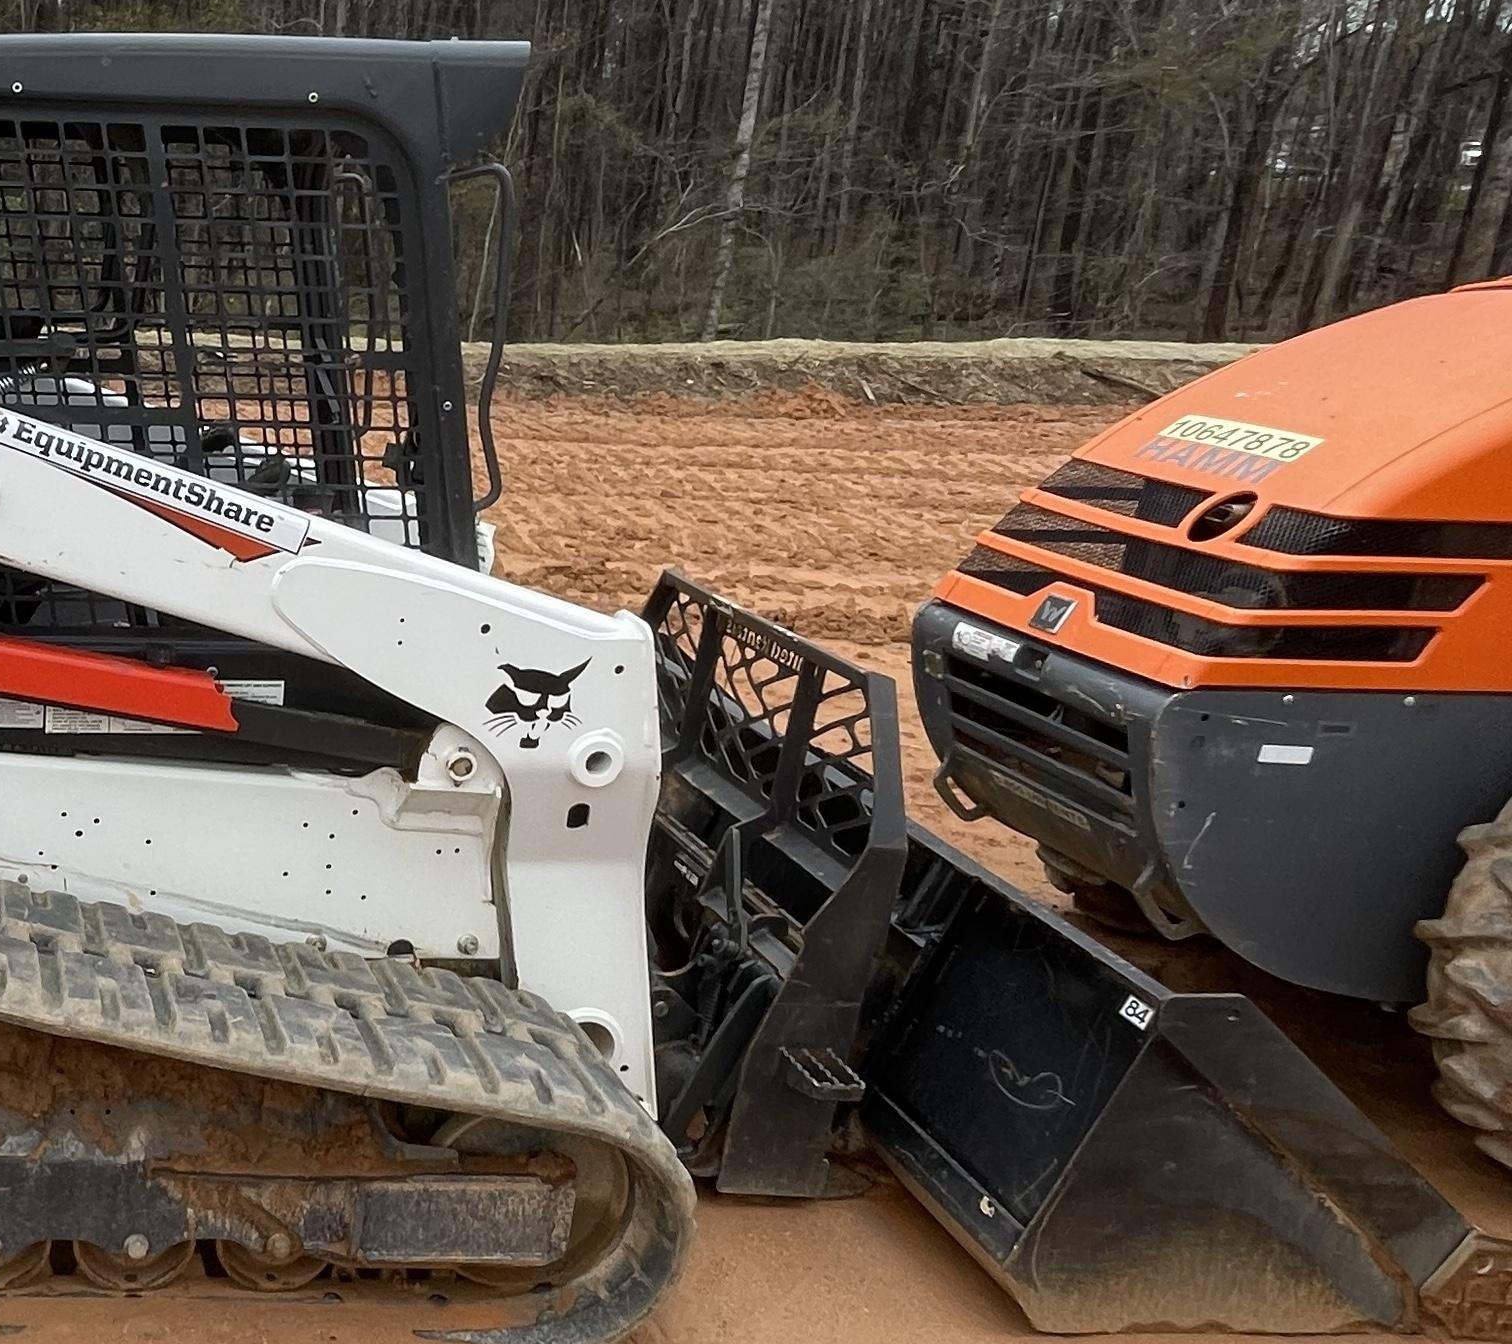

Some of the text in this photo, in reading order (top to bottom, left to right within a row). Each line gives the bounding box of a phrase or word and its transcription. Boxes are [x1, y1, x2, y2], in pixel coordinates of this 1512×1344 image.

[1167, 419, 1311, 459] 10647878
[11, 418, 275, 533] EquipmentShare
[1125, 1000, 1149, 1024] 84
